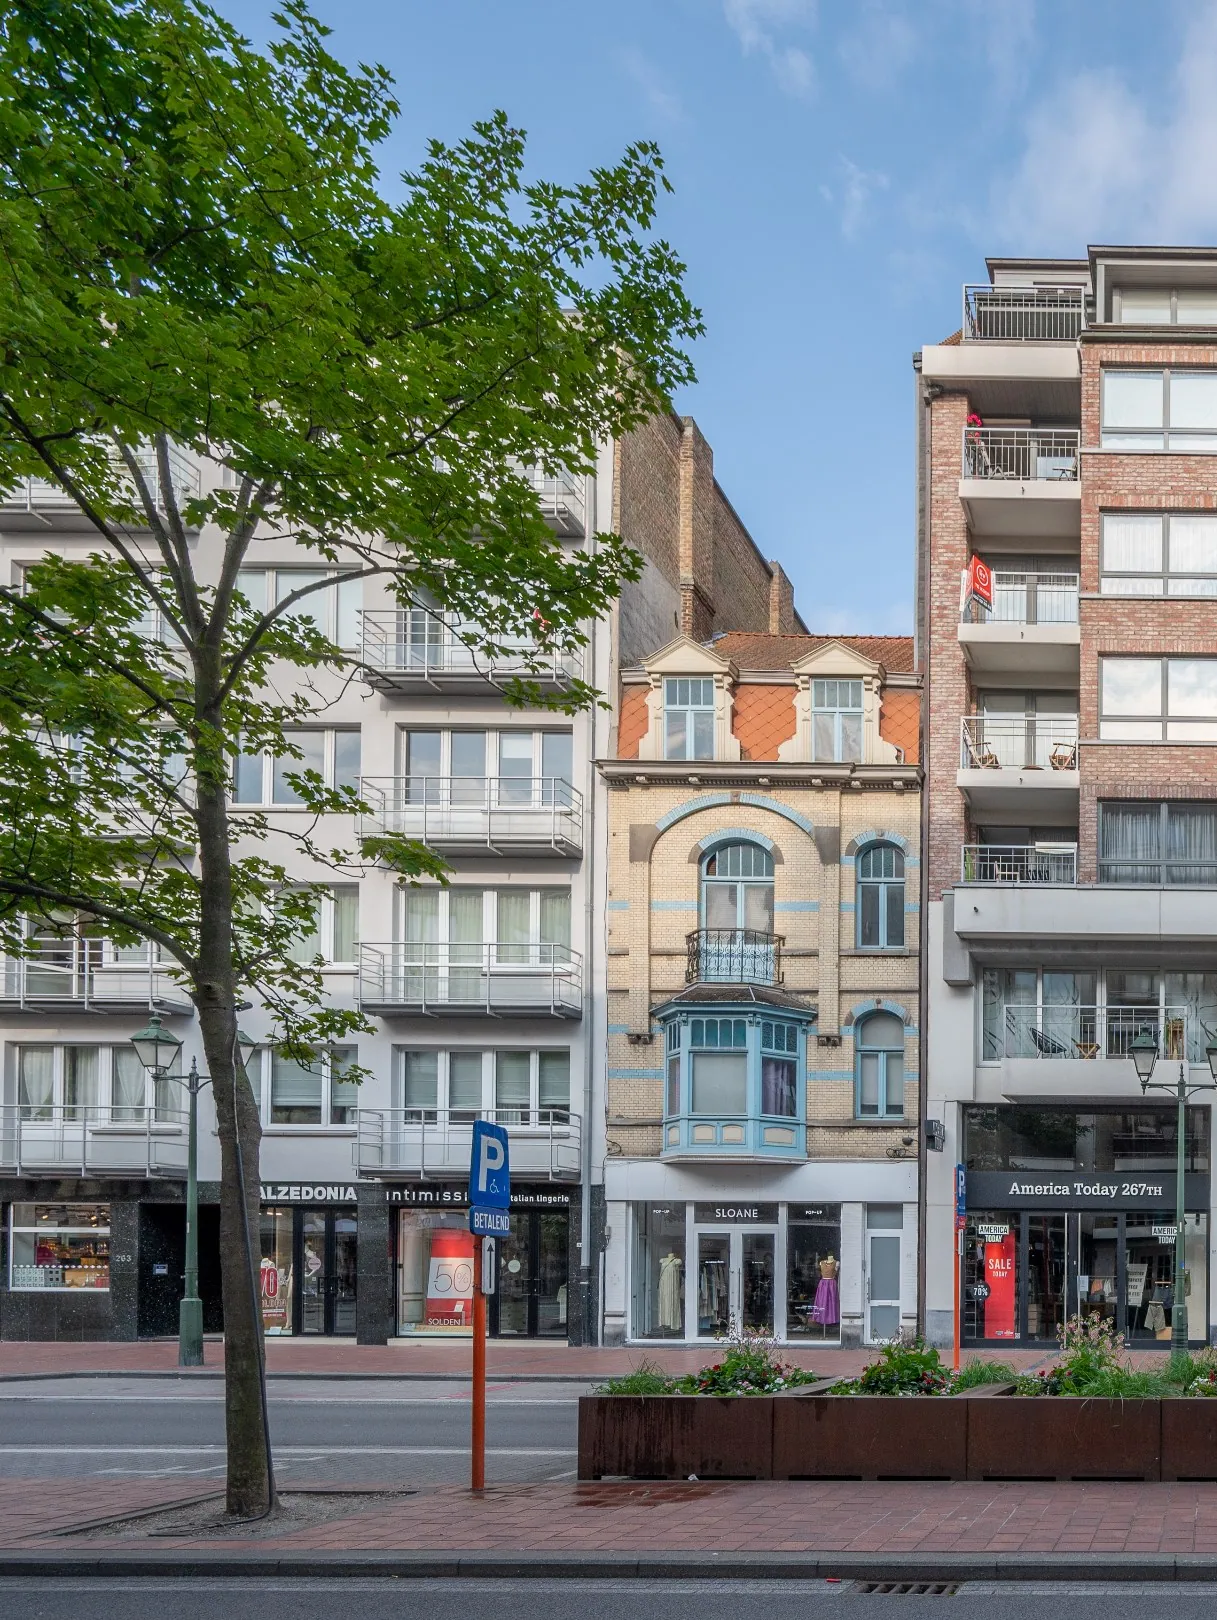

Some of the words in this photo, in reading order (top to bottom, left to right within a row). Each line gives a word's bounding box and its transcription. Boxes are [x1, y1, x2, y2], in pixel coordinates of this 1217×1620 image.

[479, 1134, 505, 1192] P
[958, 1170, 965, 1197] P
[260, 1186, 357, 1200] ALZEDONIA
[1009, 1182, 1070, 1195] America
[1074, 1182, 1118, 1198] Today
[1122, 1183, 1162, 1196] 267TH
[386, 1190, 468, 1201] intimissi
[510, 1195, 534, 1203] talian
[536, 1195, 569, 1204] lingerie
[715, 1208, 758, 1218] SLOANE
[474, 1212, 509, 1231] BETALEND
[979, 1225, 1008, 1234] AMERICA
[1153, 1227, 1177, 1235] AMERIC
[985, 1235, 1003, 1243] TODAY
[1158, 1236, 1176, 1244] TODAY
[988, 1258, 1012, 1270] SALE
[973, 1287, 988, 1297] 70%
[427, 1318, 461, 1326] SOLDEN
